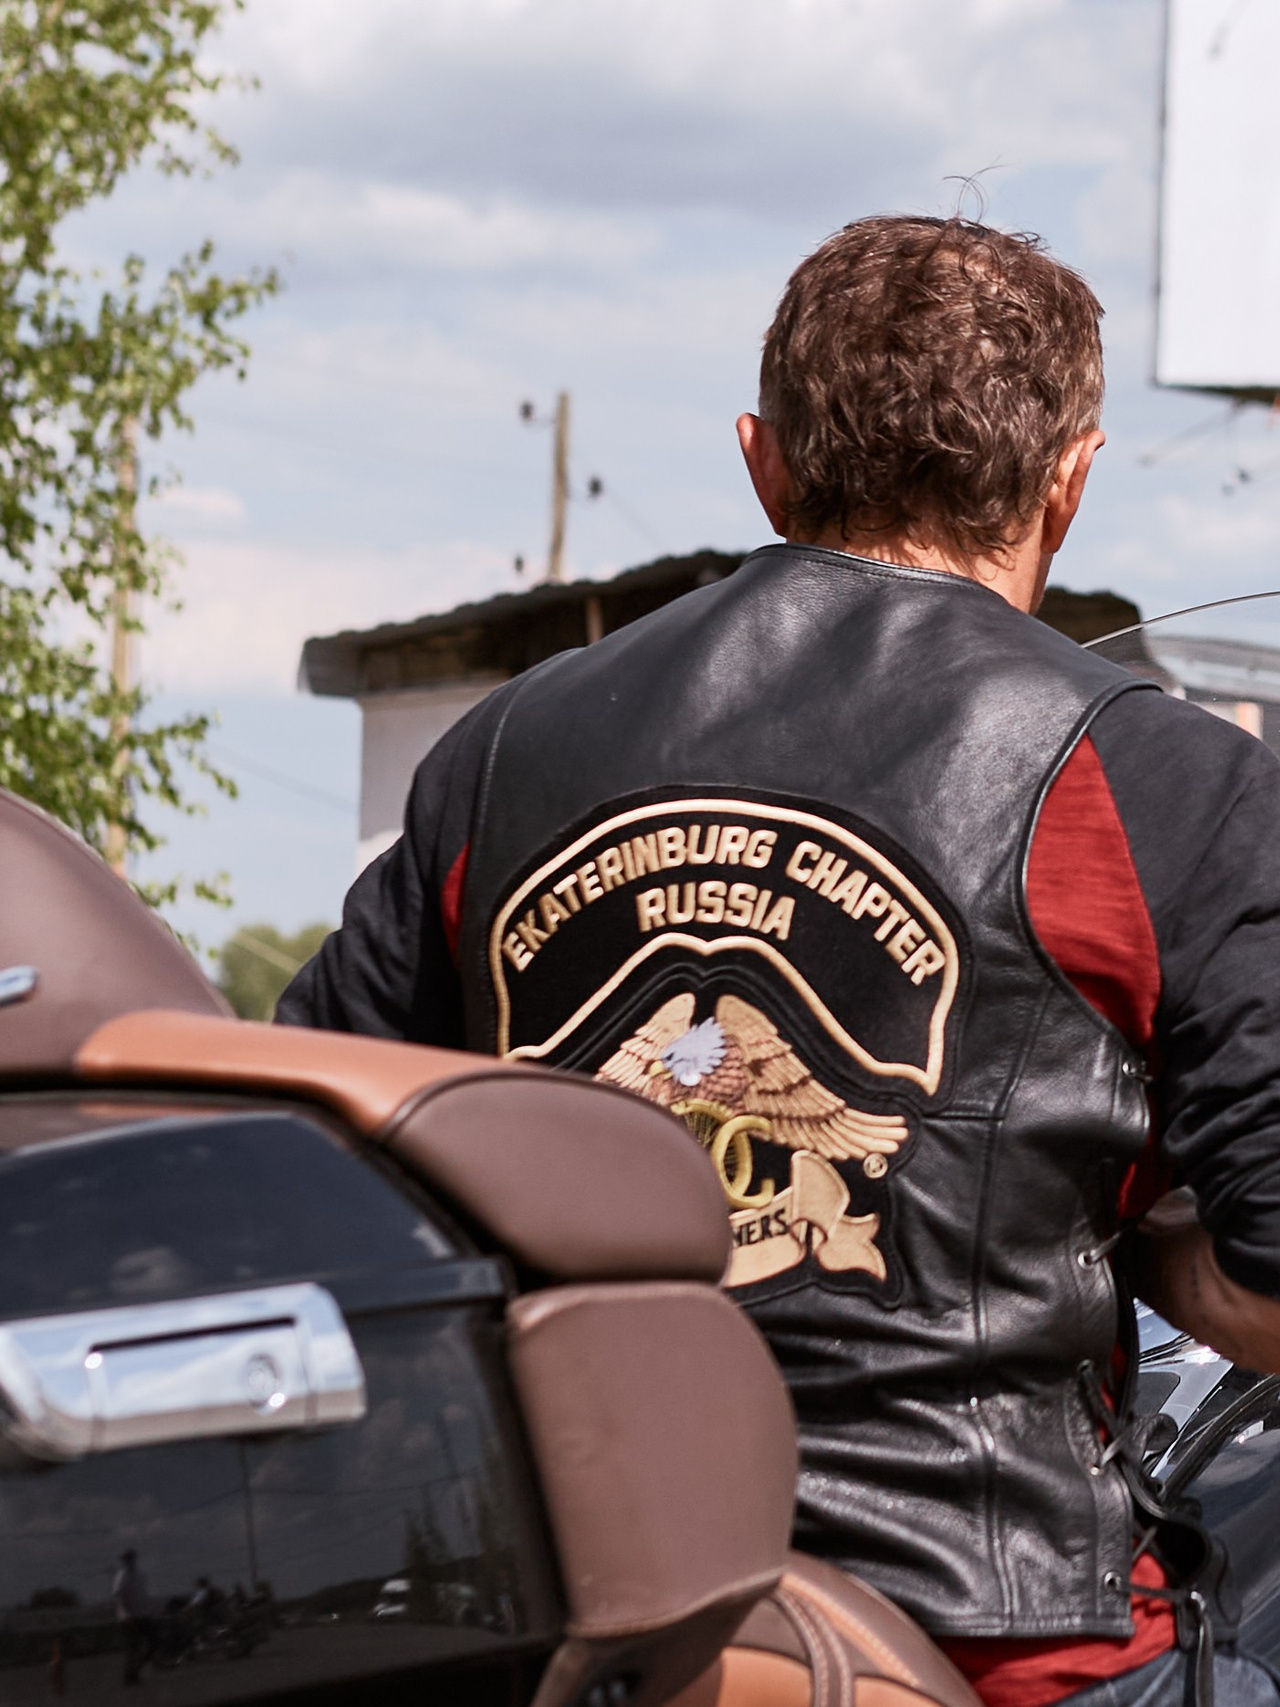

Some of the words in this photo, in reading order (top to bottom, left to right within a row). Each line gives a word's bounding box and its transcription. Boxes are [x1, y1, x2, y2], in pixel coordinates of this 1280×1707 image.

[501, 824, 778, 972] EKATERINBURG
[785, 840, 946, 986] CHAPTER
[636, 880, 796, 941] RUSSIA
